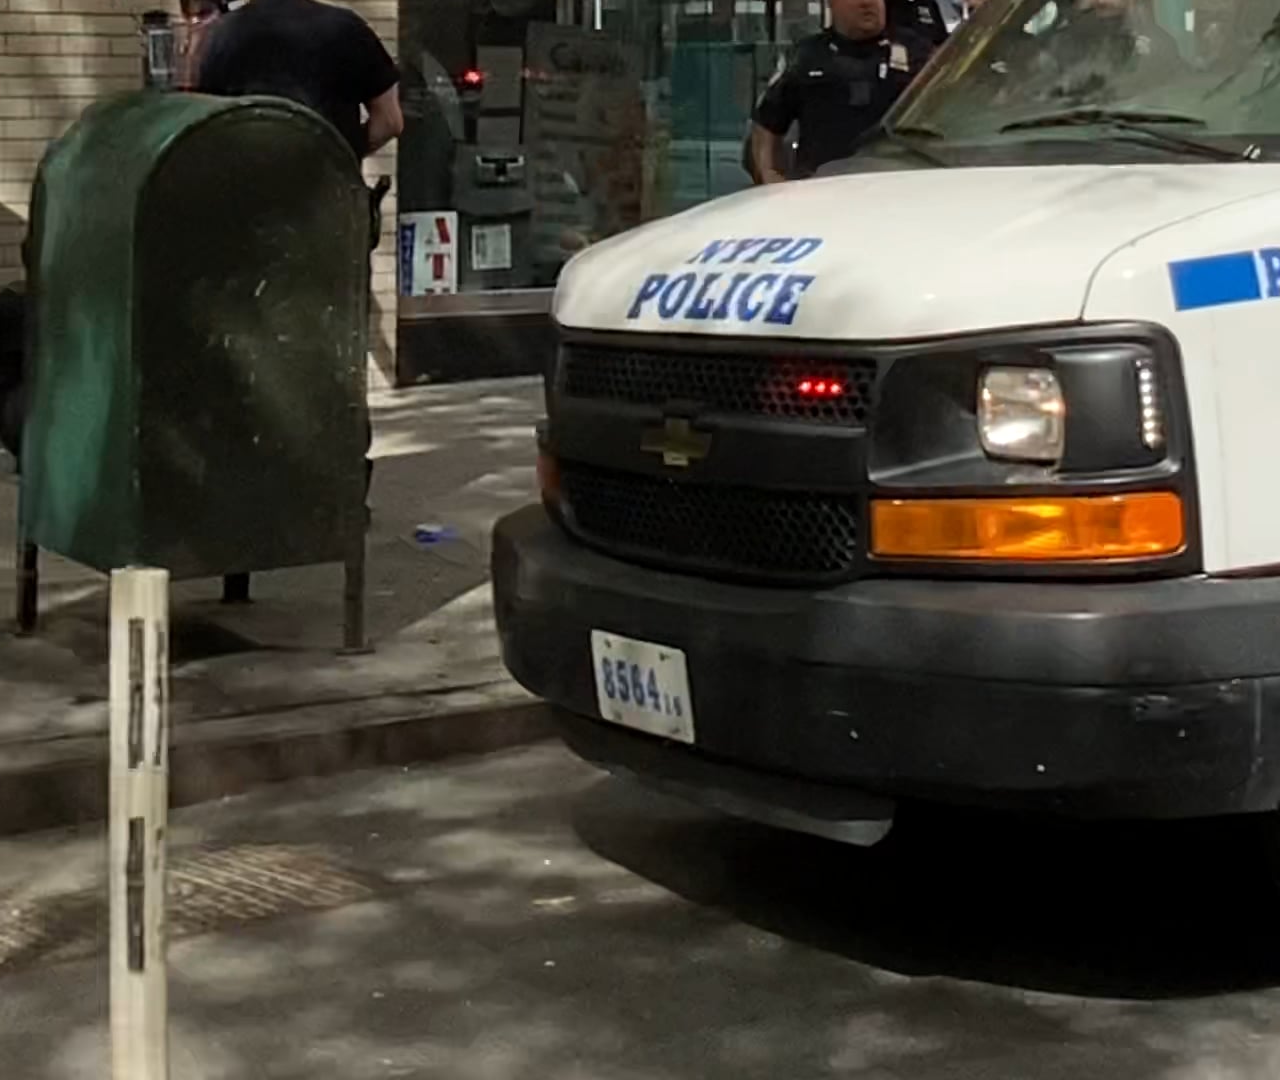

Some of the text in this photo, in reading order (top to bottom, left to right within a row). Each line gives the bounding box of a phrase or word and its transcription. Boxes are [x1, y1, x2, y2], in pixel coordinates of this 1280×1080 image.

[684, 237, 824, 264] NYPD
[626, 272, 816, 325] POLICE
[602, 657, 662, 712] 8564
